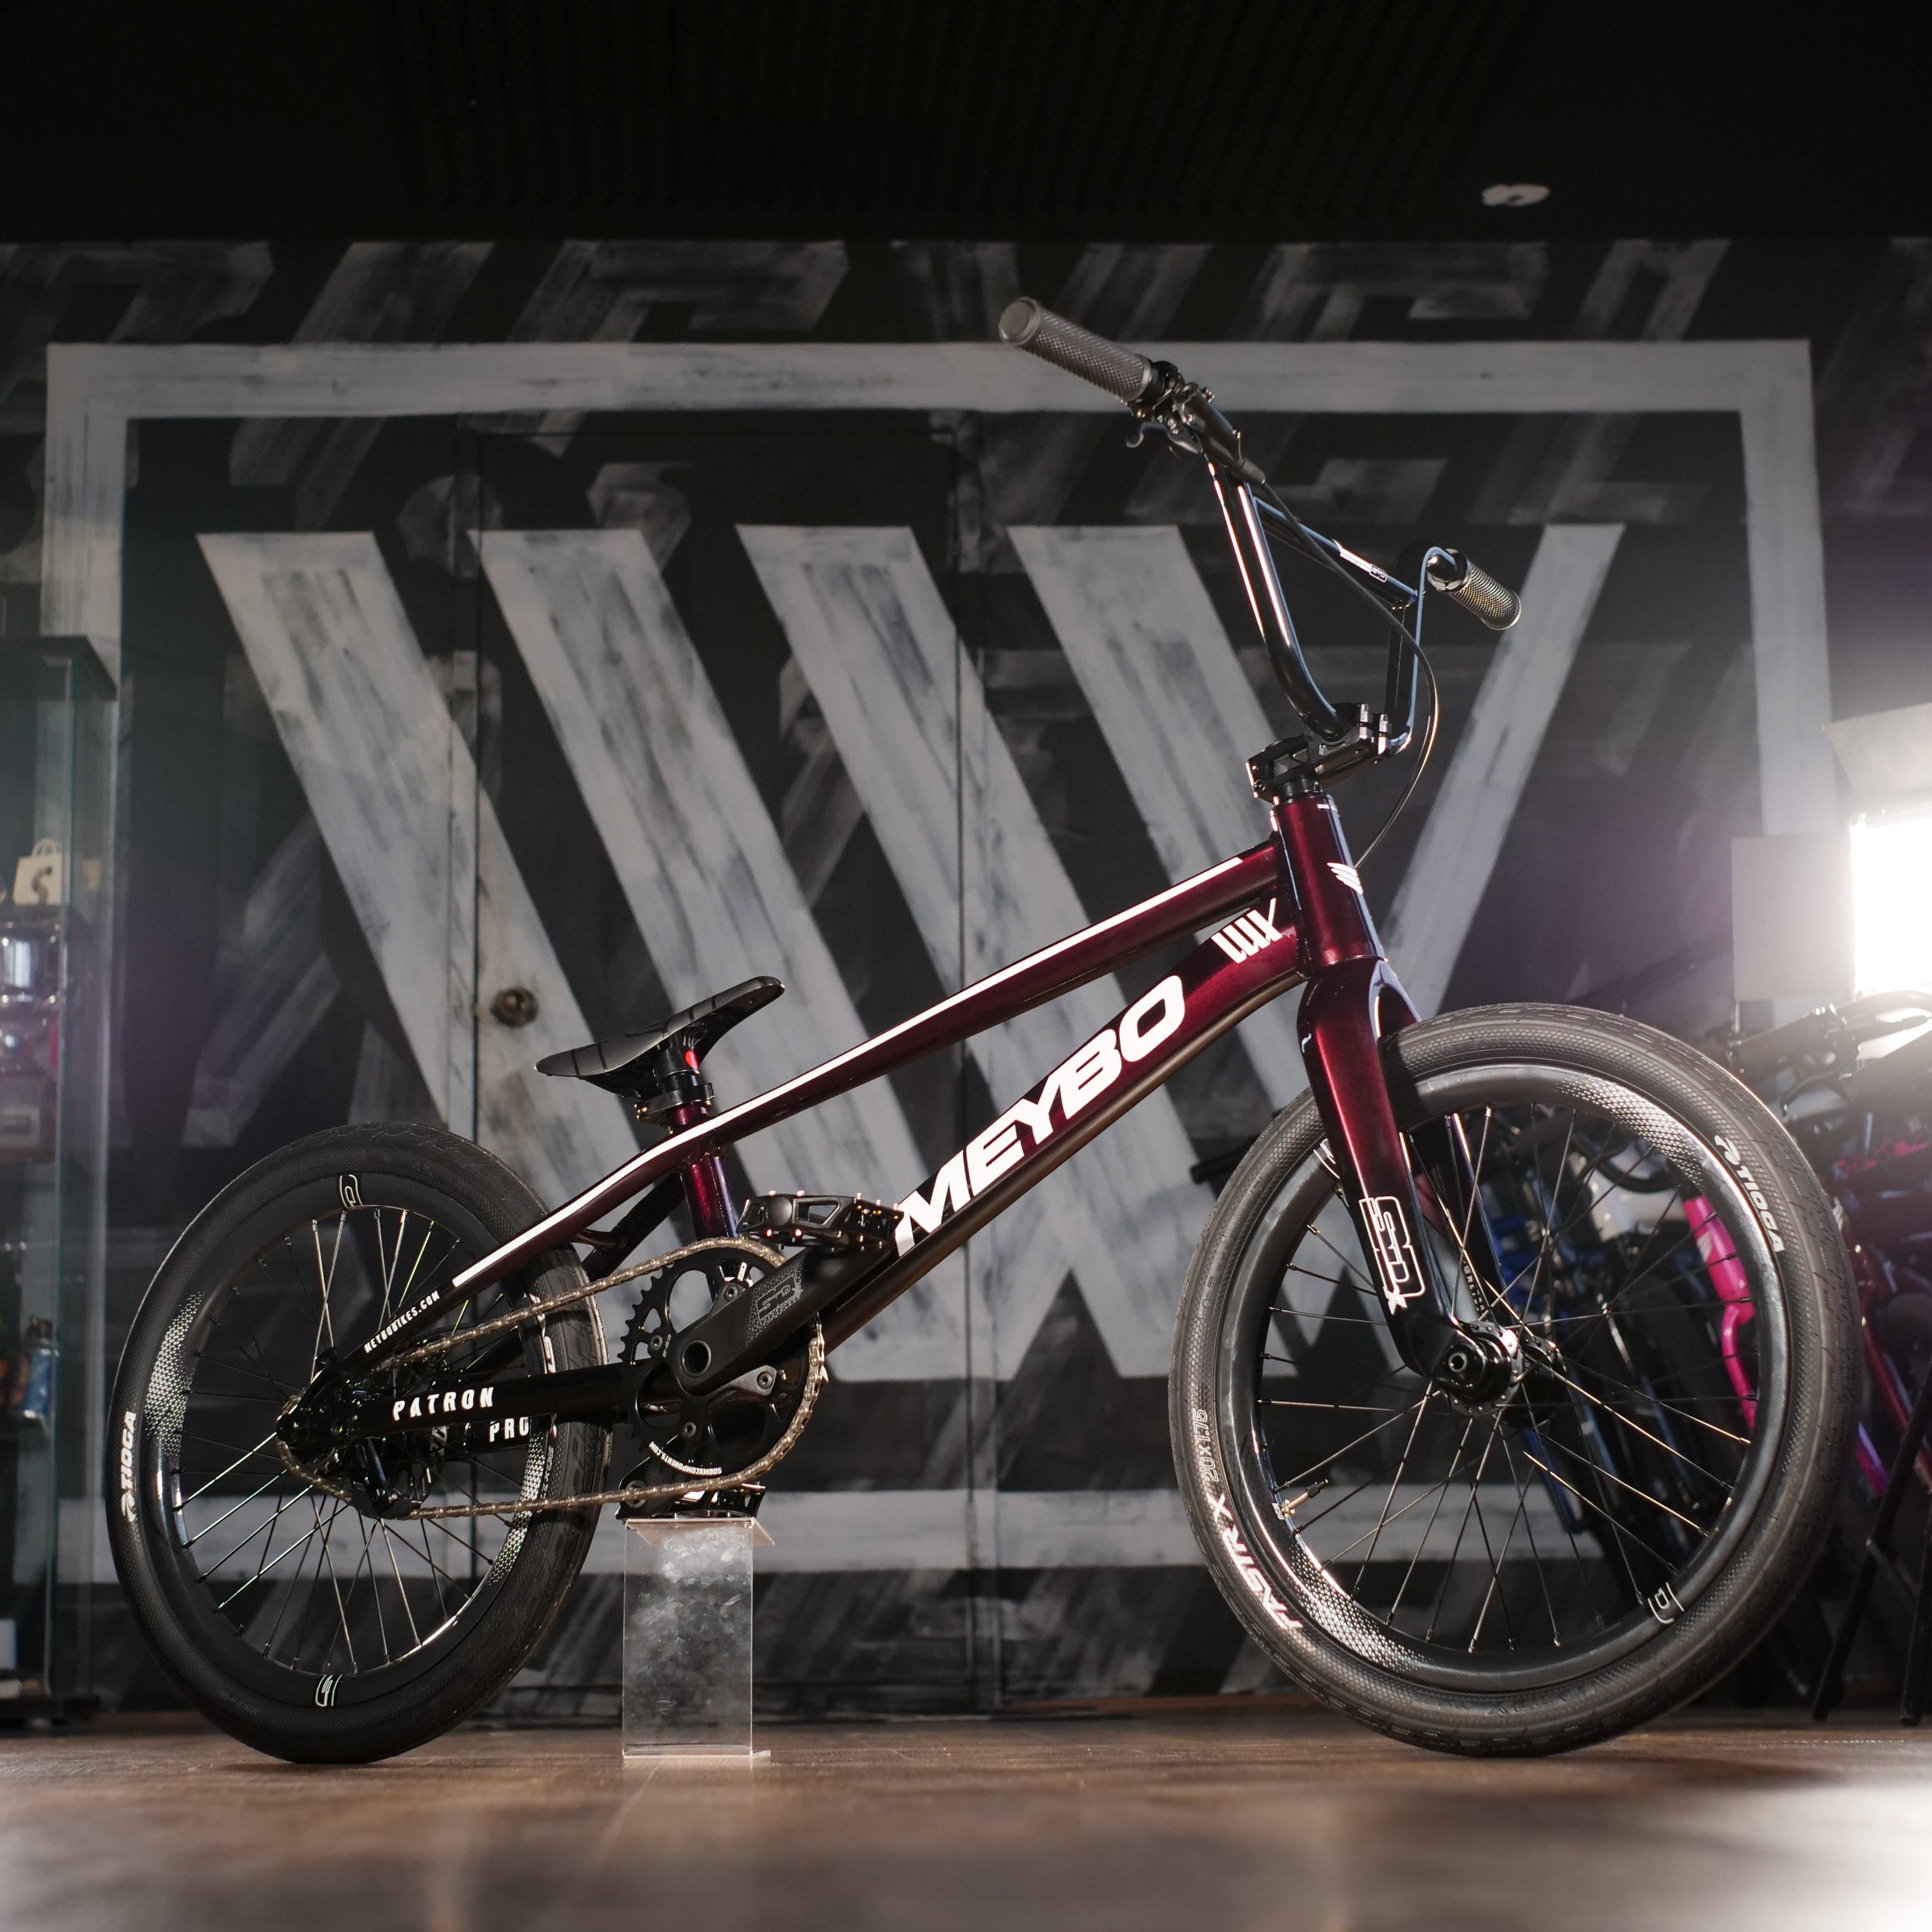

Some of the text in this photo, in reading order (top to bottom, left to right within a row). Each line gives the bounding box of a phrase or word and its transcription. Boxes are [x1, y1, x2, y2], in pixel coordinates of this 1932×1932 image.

[895, 975, 1186, 1257] MEYBO
[1736, 1165, 1785, 1252] TIOGA
[363, 1290, 441, 1353] MEYBOBIKES.COM
[392, 1386, 494, 1421] PATRON
[489, 1416, 530, 1443] PRO
[121, 1410, 137, 1490] TIOGA
[1222, 1523, 1304, 1629] FASTR
